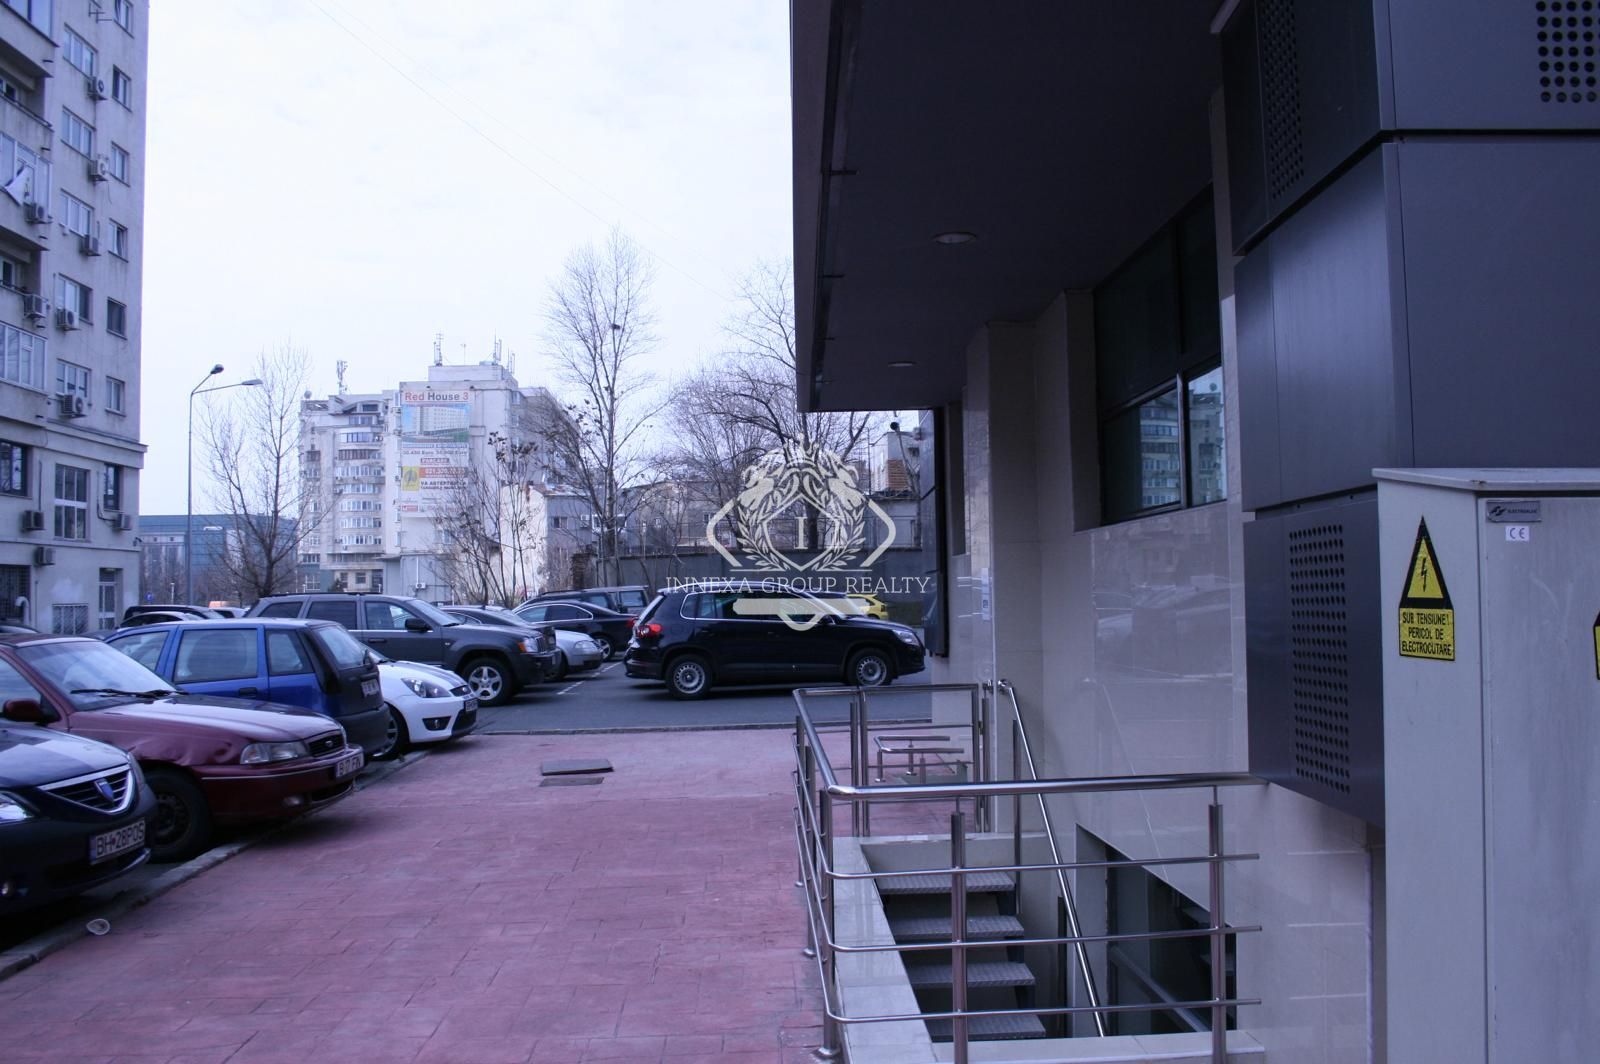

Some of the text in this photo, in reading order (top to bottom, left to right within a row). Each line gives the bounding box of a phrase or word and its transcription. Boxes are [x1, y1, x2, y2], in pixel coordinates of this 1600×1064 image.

[405, 392, 468, 400] Red House 3
[1402, 612, 1414, 624] SUB
[1408, 626, 1444, 640] PERICOL DE
[1402, 640, 1452, 656] ELECTROCUTARE
